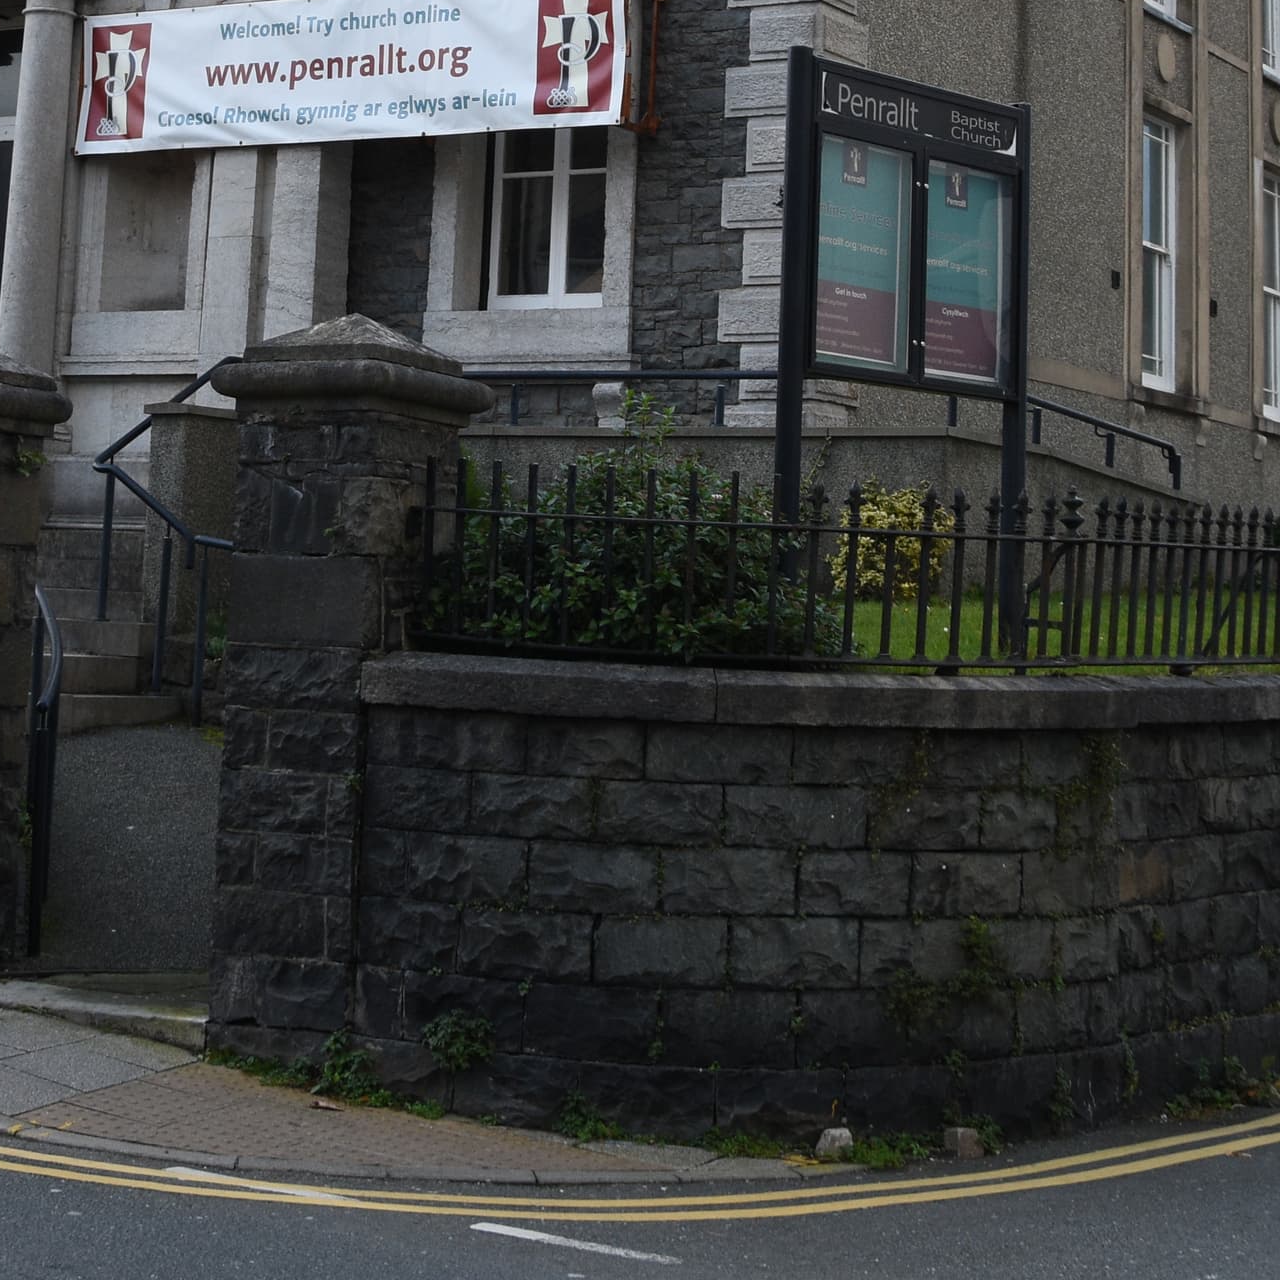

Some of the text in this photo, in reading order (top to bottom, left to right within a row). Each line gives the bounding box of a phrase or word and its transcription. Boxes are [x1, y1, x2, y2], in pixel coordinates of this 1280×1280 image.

[220, 4, 461, 40] Welcome! Try church online
[205, 43, 472, 90] www.penrallt.org
[158, 89, 517, 127] Croeso! Rhowch gynnig ar eglwys ar-lein
[838, 83, 919, 131] Penrallt
[951, 110, 1000, 133] Baptist
[951, 126, 1001, 148] Church
